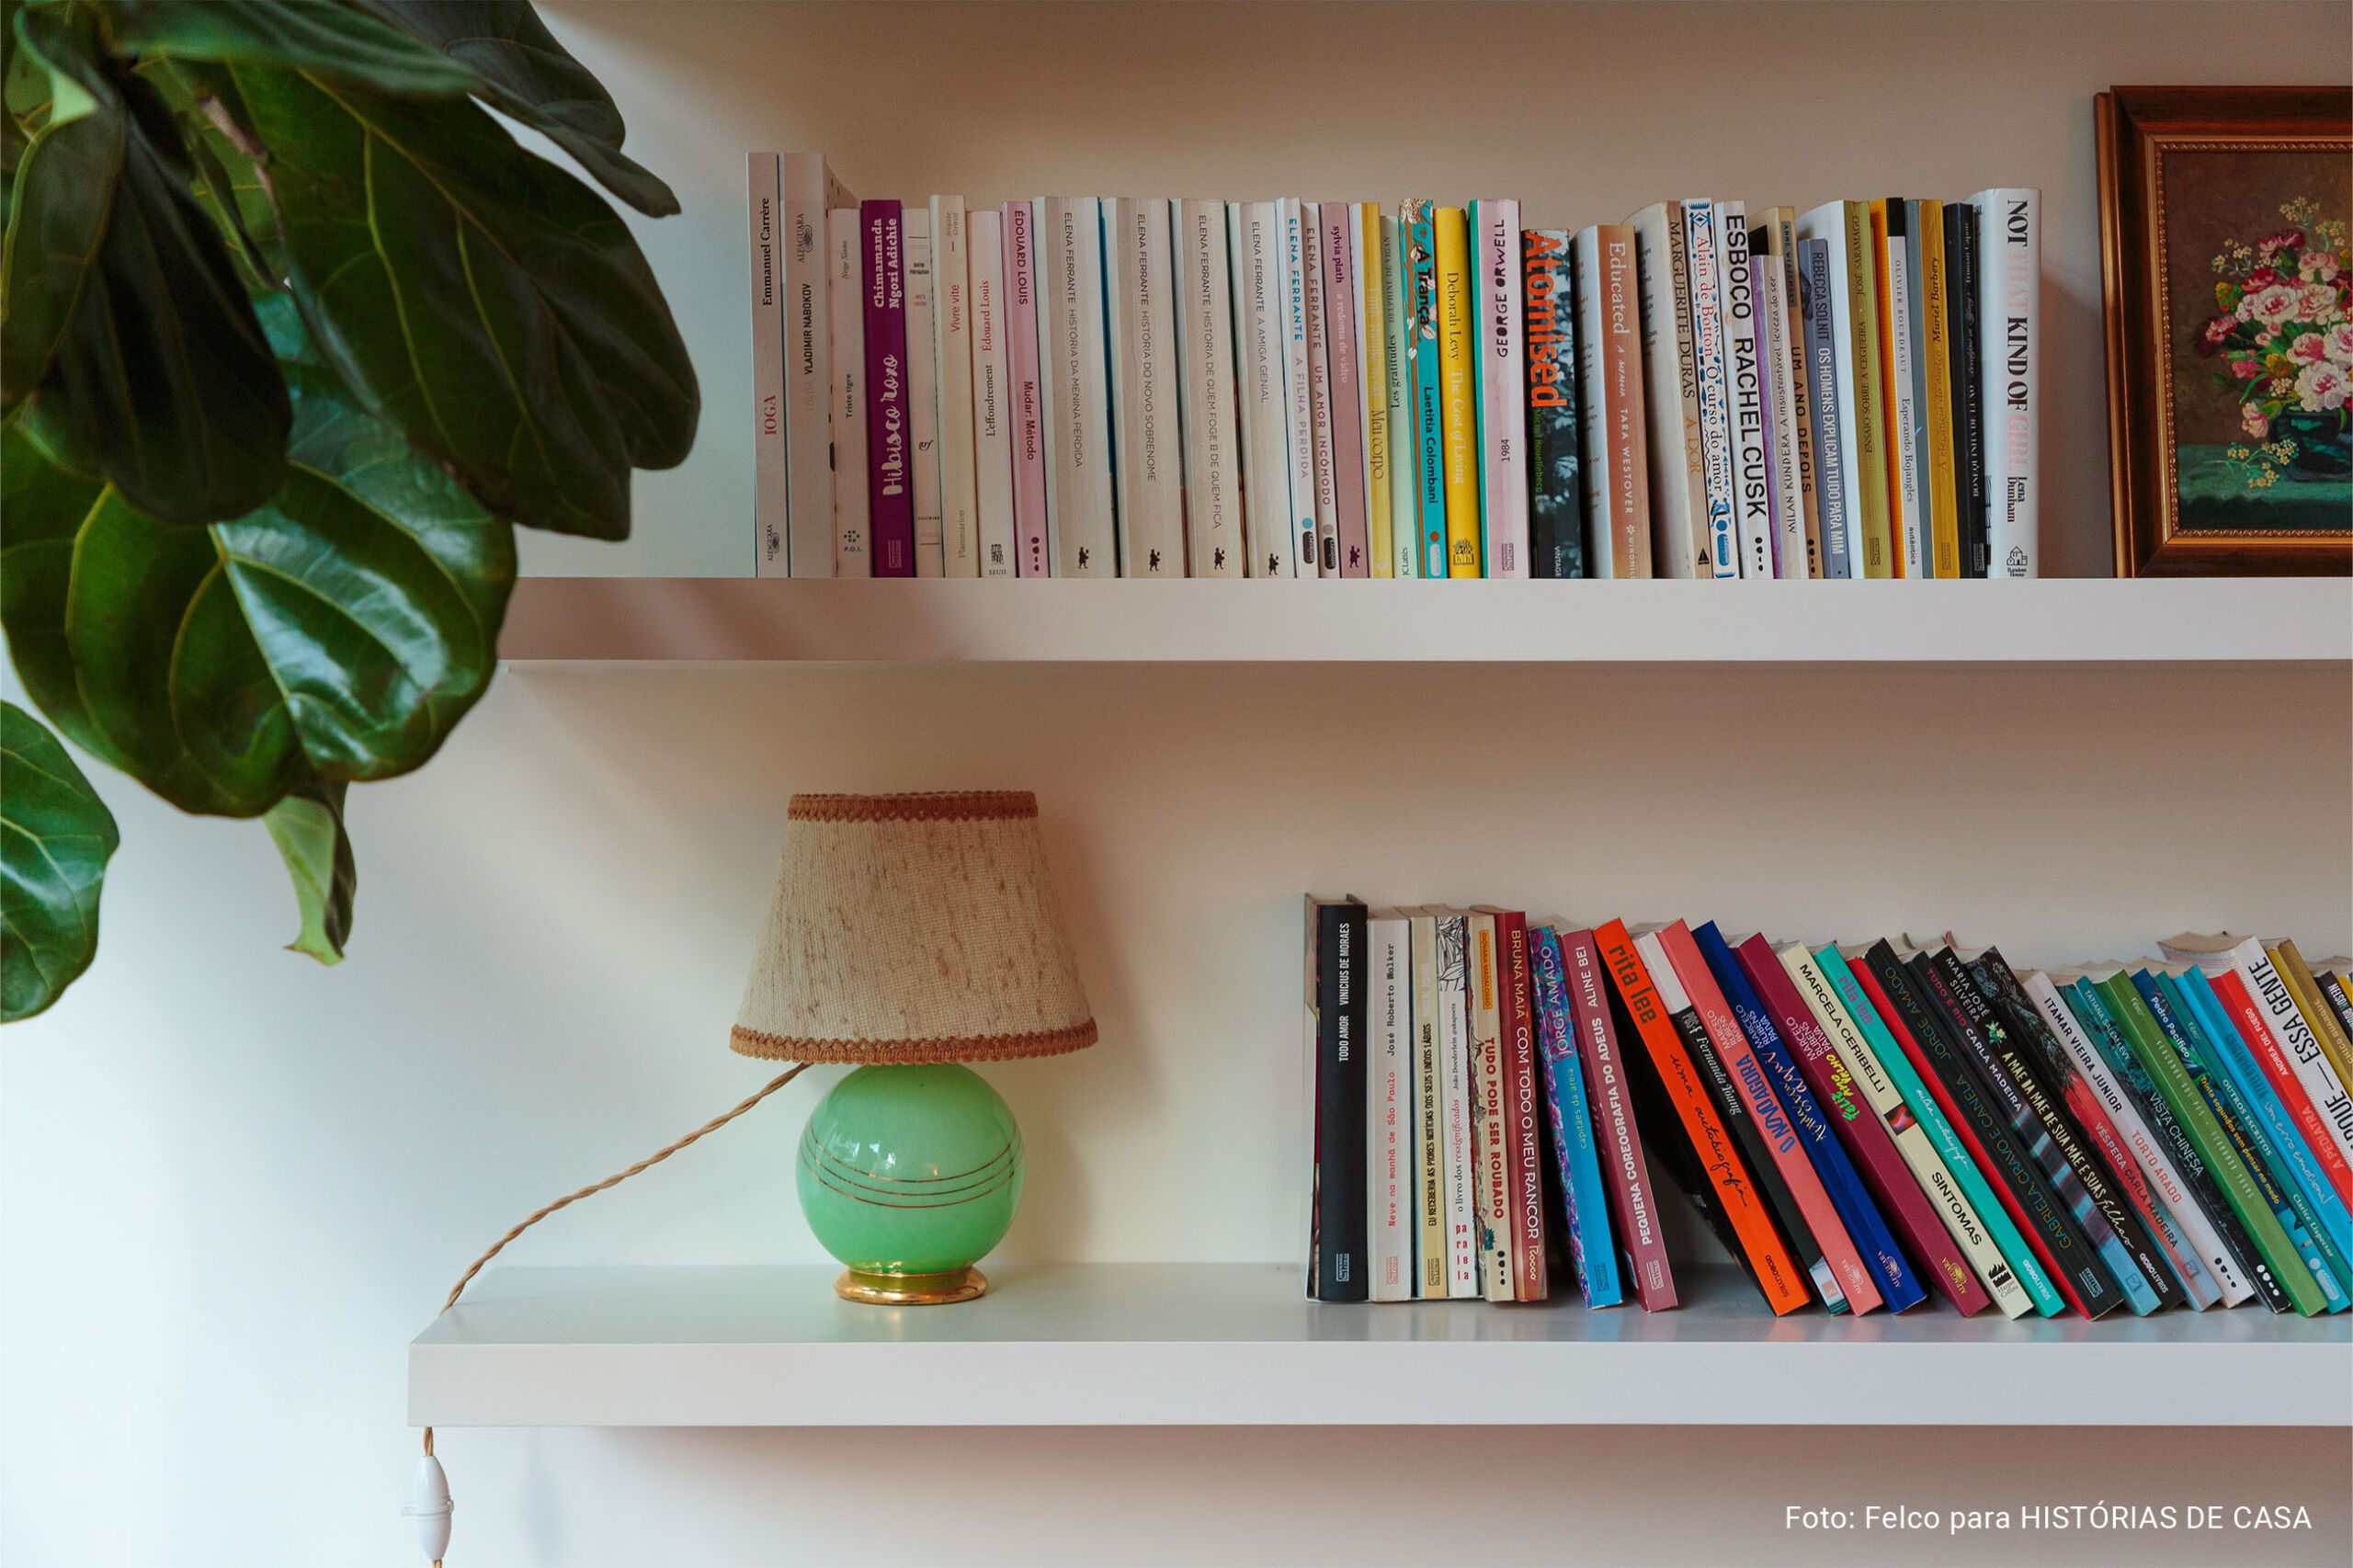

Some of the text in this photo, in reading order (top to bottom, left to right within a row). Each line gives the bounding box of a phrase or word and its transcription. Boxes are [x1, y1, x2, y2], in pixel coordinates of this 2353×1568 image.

[760, 199, 771, 305] Emmanuel Carrère
[871, 220, 883, 307] Chimamanda
[888, 219, 902, 308] Ngozi Adichie
[1015, 210, 1028, 304] ÉDOUARD LOUIS
[1495, 220, 1508, 358] GEORGE ORWELL
[1608, 242, 1630, 334] Educated
[802, 284, 813, 375] VLADIMIR NABOKOV
[980, 280, 991, 351] Édouard Louis
[1064, 212, 1083, 467] ELENA FERRANTE HISTÓRIA DA MENINA PERDIDA
[1447, 273, 1461, 359] Deborah Levy
[1525, 232, 1567, 407] Atomised
[1669, 221, 1695, 398] MARGUERITE DURAS
[1813, 253, 1829, 340] REBECCA SOLNIT
[1895, 260, 1906, 373] OLIVIER BOURDEAUT
[1930, 257, 1941, 342] Muriel Barbery
[2007, 200, 2029, 471] NOT THAT KIND OF GIRL
[1289, 219, 1309, 479] ELENA FERRANTE A FILHA PERDIDA
[1389, 335, 1401, 408] Les gratitudes
[1697, 236, 1723, 491] Alain de Botton O curso do amor
[1726, 215, 1767, 518] ESBOÇO RACHEL CUSK
[764, 396, 777, 435] IOGA
[1024, 381, 1036, 460] Mudar: Método
[1424, 387, 1438, 504] Laetitia Colombani
[1450, 369, 1468, 484] The Cost of Living
[1501, 439, 1510, 462] 1984
[1819, 348, 1844, 554] OS HOMENS EXPLICAM TUDO PARA MIM
[1901, 399, 1915, 502] Esperando Bojangles
[1620, 409, 1632, 513] TARA WESTOVER
[2007, 477, 2018, 522] Dunham
[2018, 477, 2028, 502] Lena
[1339, 924, 1349, 1006] VINICIUS DE MORAES
[1511, 931, 1526, 1018] BRUNA MAIA
[1540, 946, 1573, 1057] JORGE AMADO
[1575, 947, 1597, 1006] ALINE BEI
[1608, 945, 1657, 1024] rita lee
[1838, 976, 1873, 1025] rita lee
[1946, 957, 1990, 1017] MARIA JOSÉ
[1949, 980, 1980, 1023] SILVEIRA
[1339, 1016, 1349, 1062] TODO AMOR
[1735, 1005, 1764, 1049] MARCELO
[1749, 1010, 1771, 1049] RUBENS
[1761, 1015, 1779, 1042] PAIVA
[1786, 1017, 1817, 1061] MARCELO
[1800, 964, 1885, 1093] MARCELA CERIBELLI
[1802, 1022, 1825, 1057] RUBENS
[1813, 1026, 1832, 1051] PAIVA
[1885, 966, 1952, 1060] JORGE AMADO
[2151, 996, 2189, 1058] Pedro Pacífico
[2248, 956, 2321, 1064] ESSA GENTE
[1697, 1037, 1742, 1116] Fernanda Young
[1966, 1028, 2022, 1111] CARLA MADEIRA
[2044, 997, 2122, 1113] ITAMAR VIEIRA JUNIOR
[1484, 1038, 1504, 1219] TUDO PODE SER ROUBADO
[1517, 1027, 1539, 1239] COM TODO O MEU RANCOR
[1592, 1017, 1652, 1245] PEQUENA COREOGRAFIA DO ADEUS
[2095, 1122, 2126, 1169] VÉSPERA
[2149, 1091, 2204, 1177] VISTA CHINESA
[2222, 1079, 2272, 1156] OUTROS ESCRITOS
[1931, 1172, 1982, 1245] SINTOMAS
[2125, 1168, 2177, 1248] CARLA MADEIRA
[2131, 1131, 2182, 1204] TORTO ARADO
[2292, 1193, 2311, 1221] Clarice
[2311, 1221, 2335, 1258] Lispector
[2140, 1253, 2168, 1293] GLOBOLIVROS
